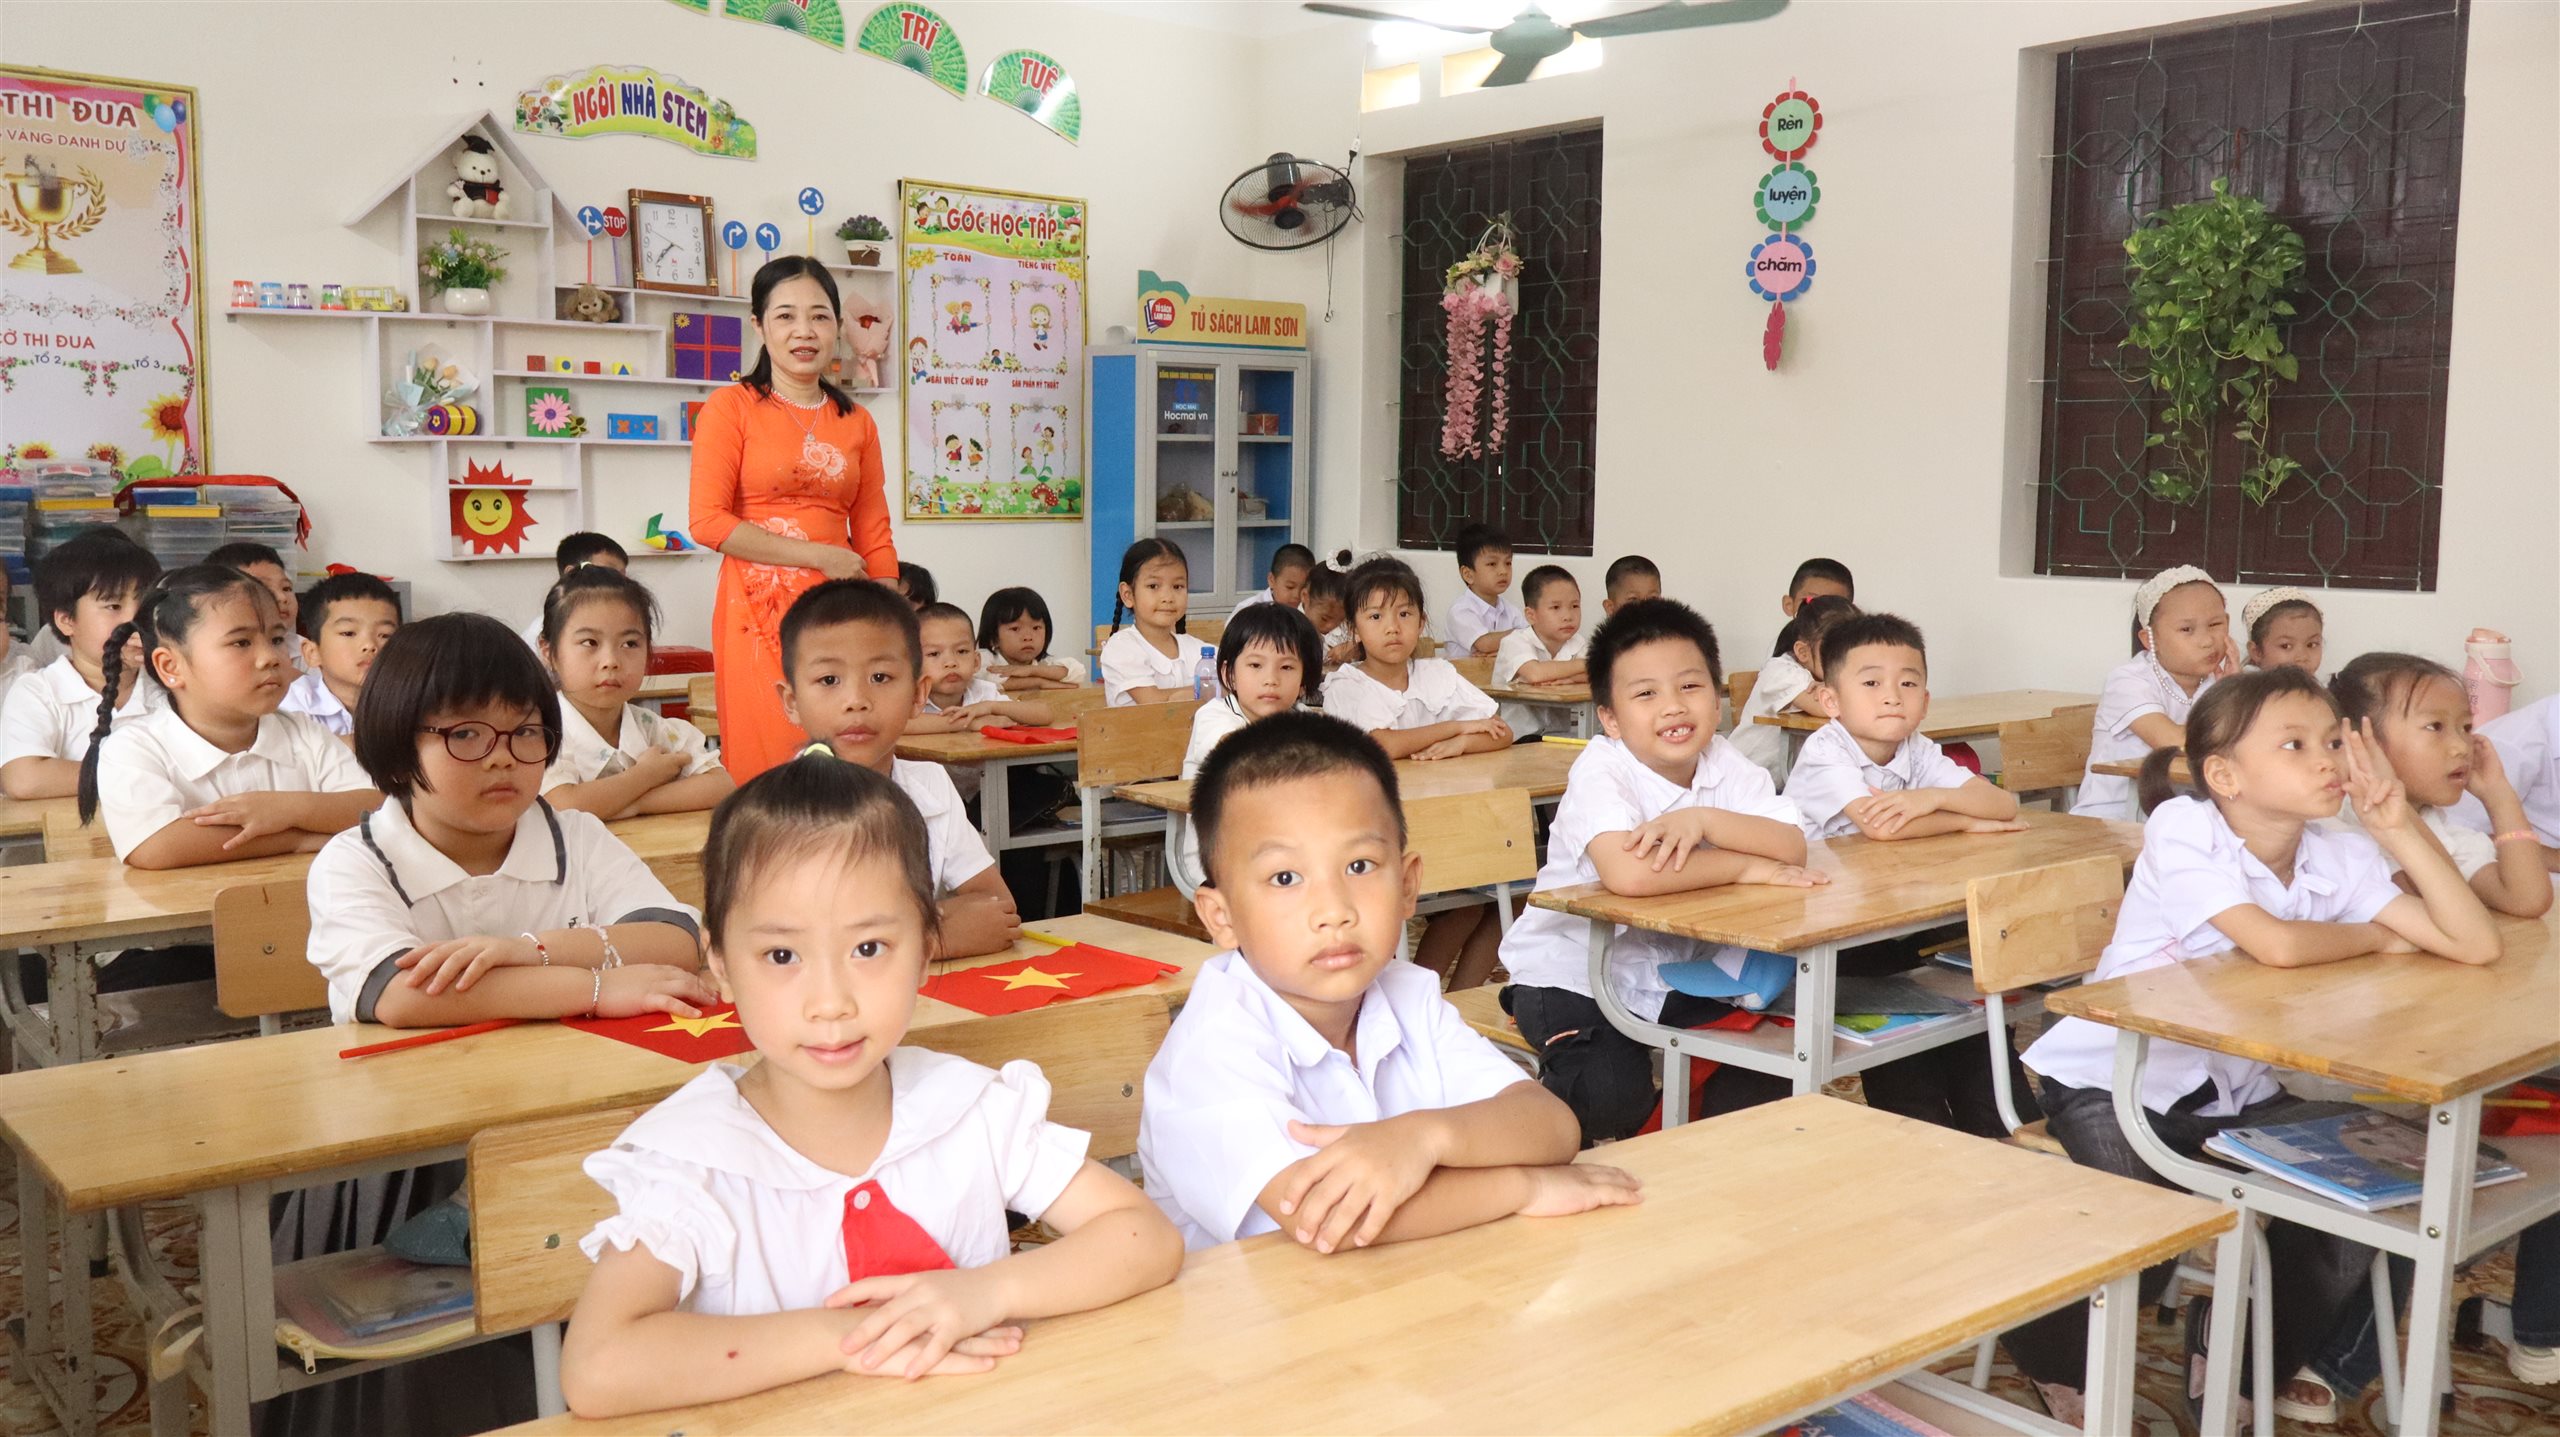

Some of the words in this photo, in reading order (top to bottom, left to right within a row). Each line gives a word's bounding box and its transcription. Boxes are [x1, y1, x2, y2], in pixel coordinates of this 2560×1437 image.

[901, 12, 941, 51] TRÍ
[2, 93, 53, 119] THI
[72, 100, 137, 128] ĐUA
[573, 76, 616, 126] NGÔI
[621, 77, 657, 119] NHÀ
[662, 90, 708, 141] STEM
[1777, 114, 1804, 132] Rèn
[7, 128, 53, 144] VÀNG
[58, 135, 100, 150] DANH
[105, 140, 127, 154] DỰ
[1769, 185, 1808, 205] luyện
[604, 215, 626, 230] STOP
[947, 204, 984, 233] GÓC
[990, 213, 1023, 244] HỌC
[1029, 213, 1058, 247] TẬP
[1191, 304, 1205, 332] TỦ
[1210, 309, 1241, 334] SÁCH
[1245, 314, 1271, 336] LAM
[1274, 316, 1298, 337] SƠN
[0, 328, 17, 346] Ờ
[23, 333, 49, 347] THI
[56, 335, 95, 350] ĐUA
[35, 352, 50, 364] TỔ
[54, 356, 62, 364] 2
[135, 355, 149, 368] TỔ
[153, 360, 161, 369] 3
